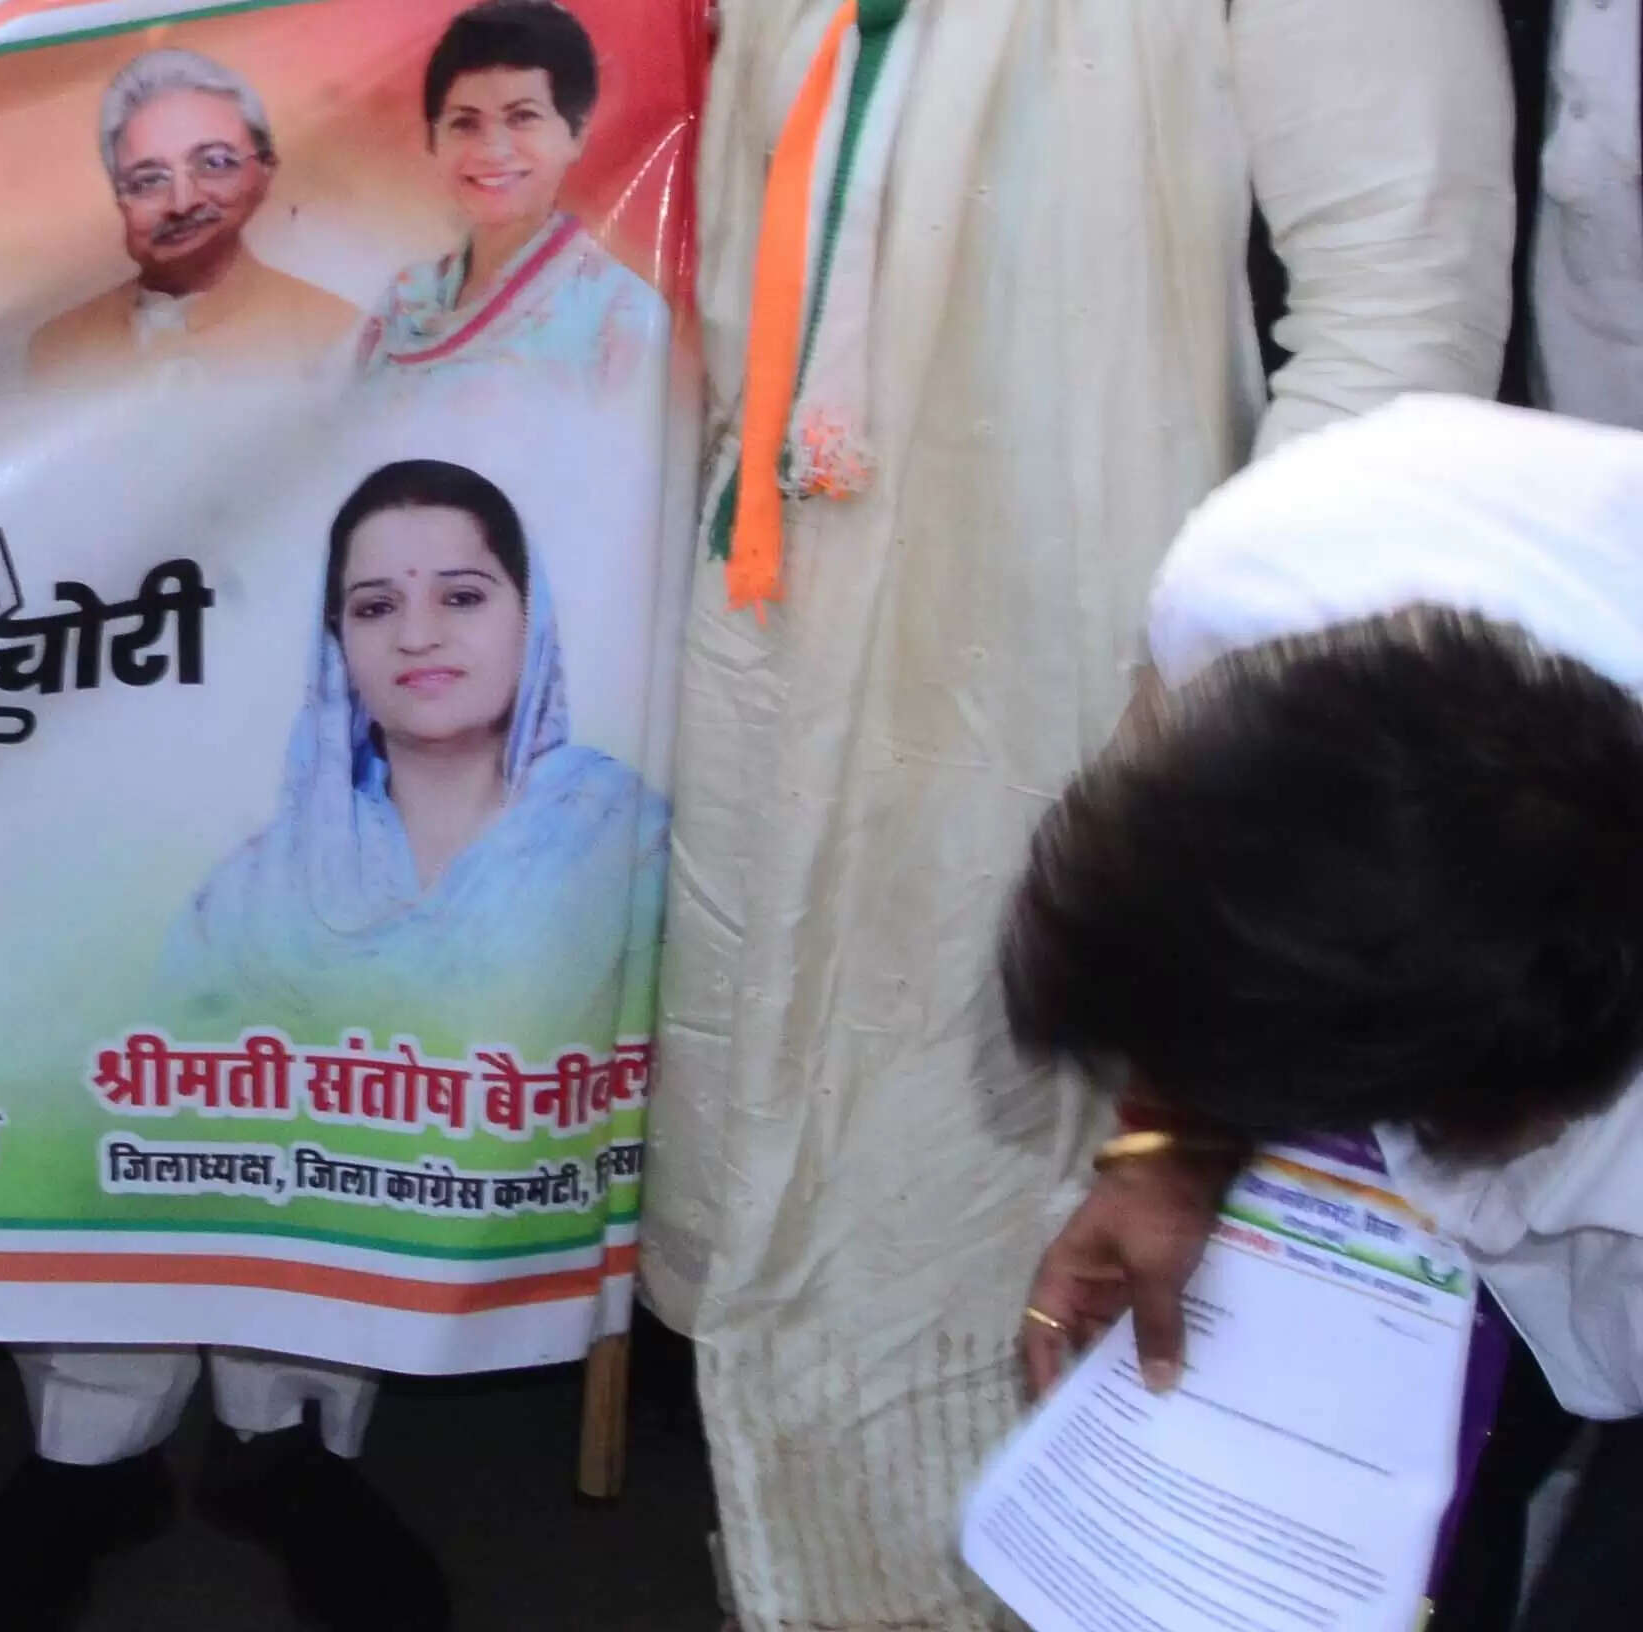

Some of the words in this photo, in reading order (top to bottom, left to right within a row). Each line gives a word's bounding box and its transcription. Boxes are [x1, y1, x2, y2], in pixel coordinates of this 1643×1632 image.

[94, 1032, 293, 1109] श्रीमती
[307, 1037, 472, 1129] संतोष
[294, 1148, 379, 1199] जिला
[385, 1162, 489, 1211] कांग्रेस
